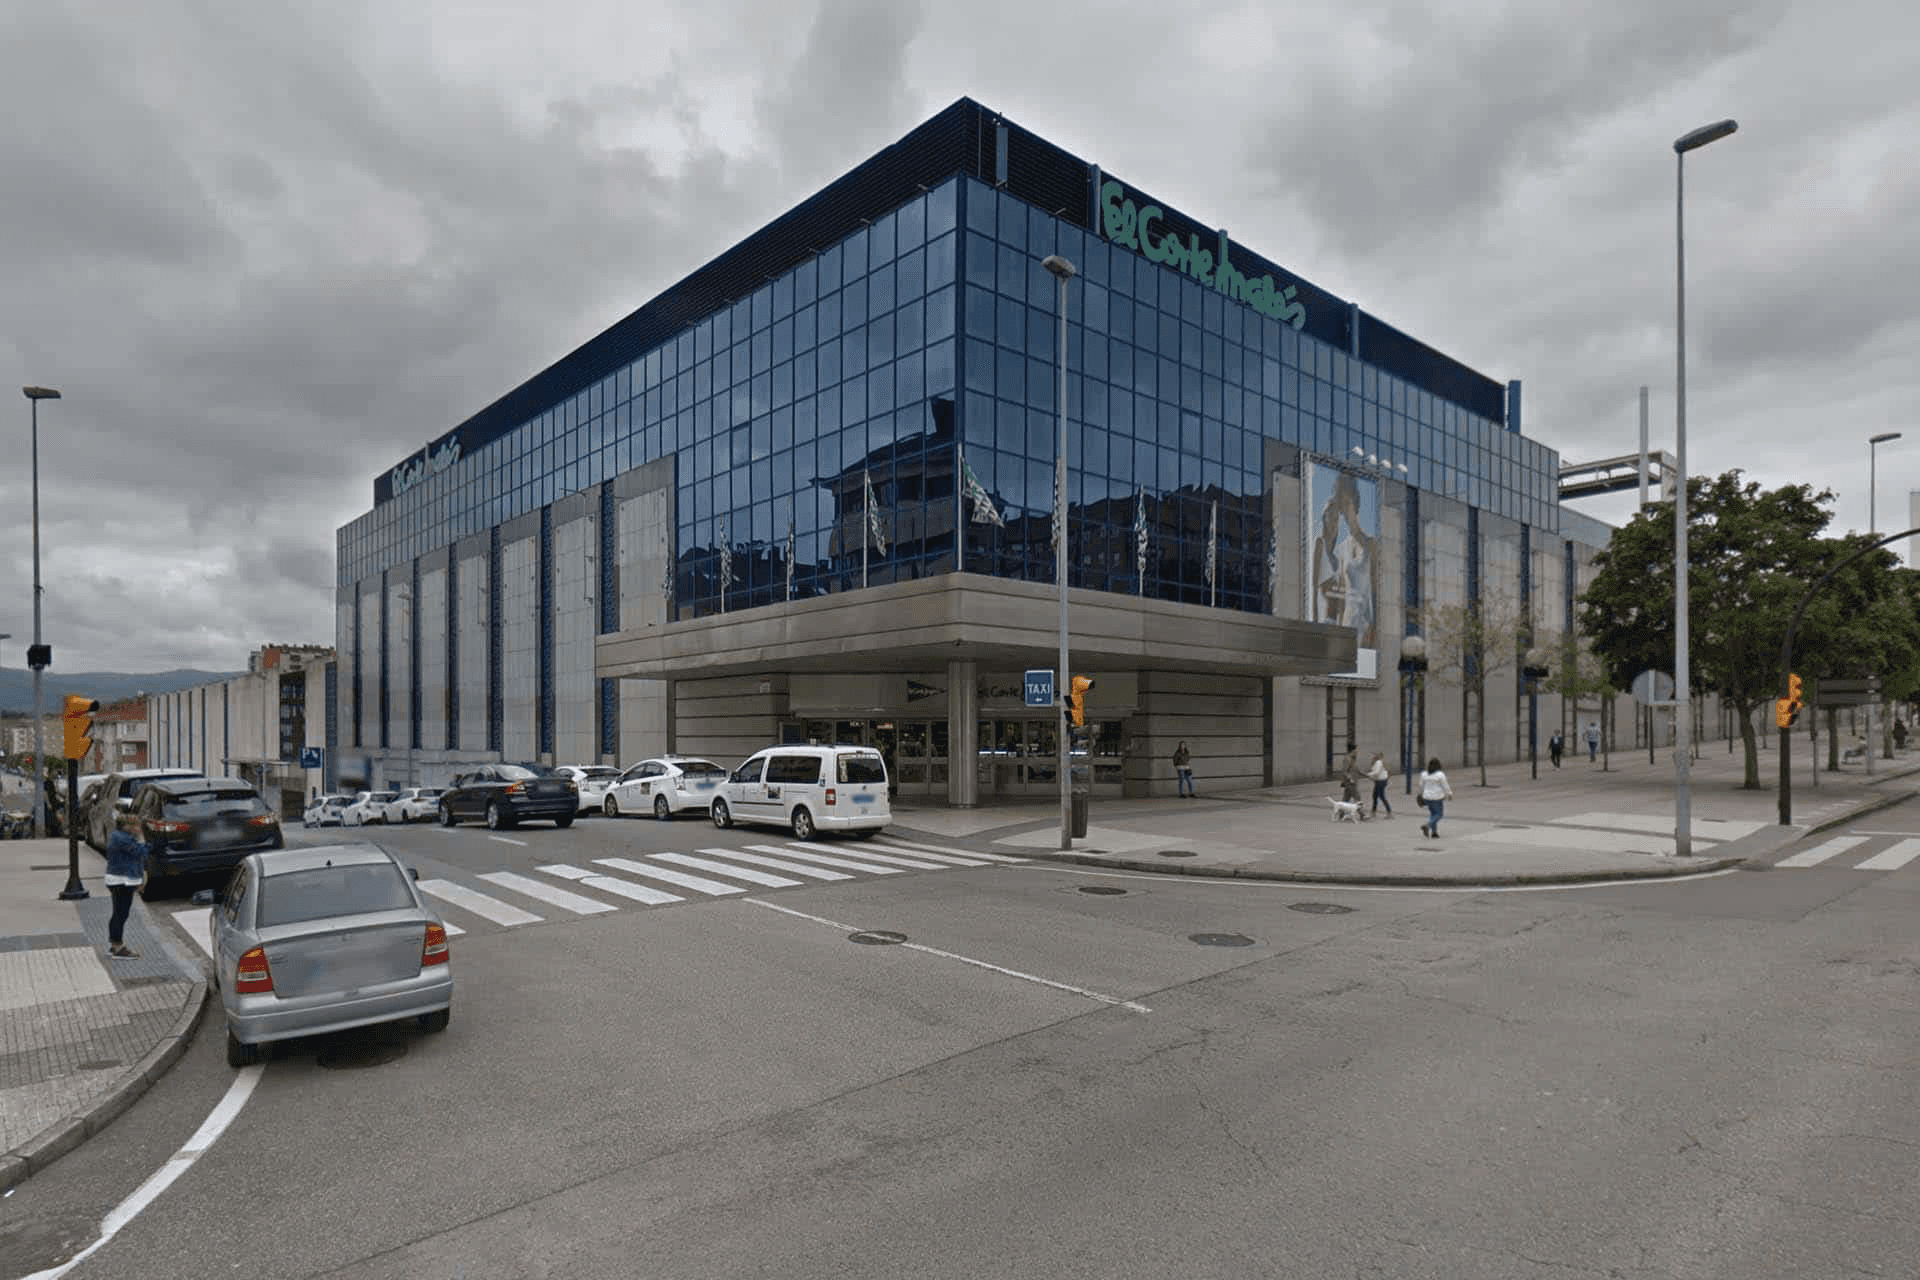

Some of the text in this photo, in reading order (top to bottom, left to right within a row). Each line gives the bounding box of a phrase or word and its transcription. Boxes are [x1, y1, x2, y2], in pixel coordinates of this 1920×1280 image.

[1101, 181, 1138, 250] El
[1138, 204, 1214, 287] Corte
[1027, 683, 1050, 694] TAXI
